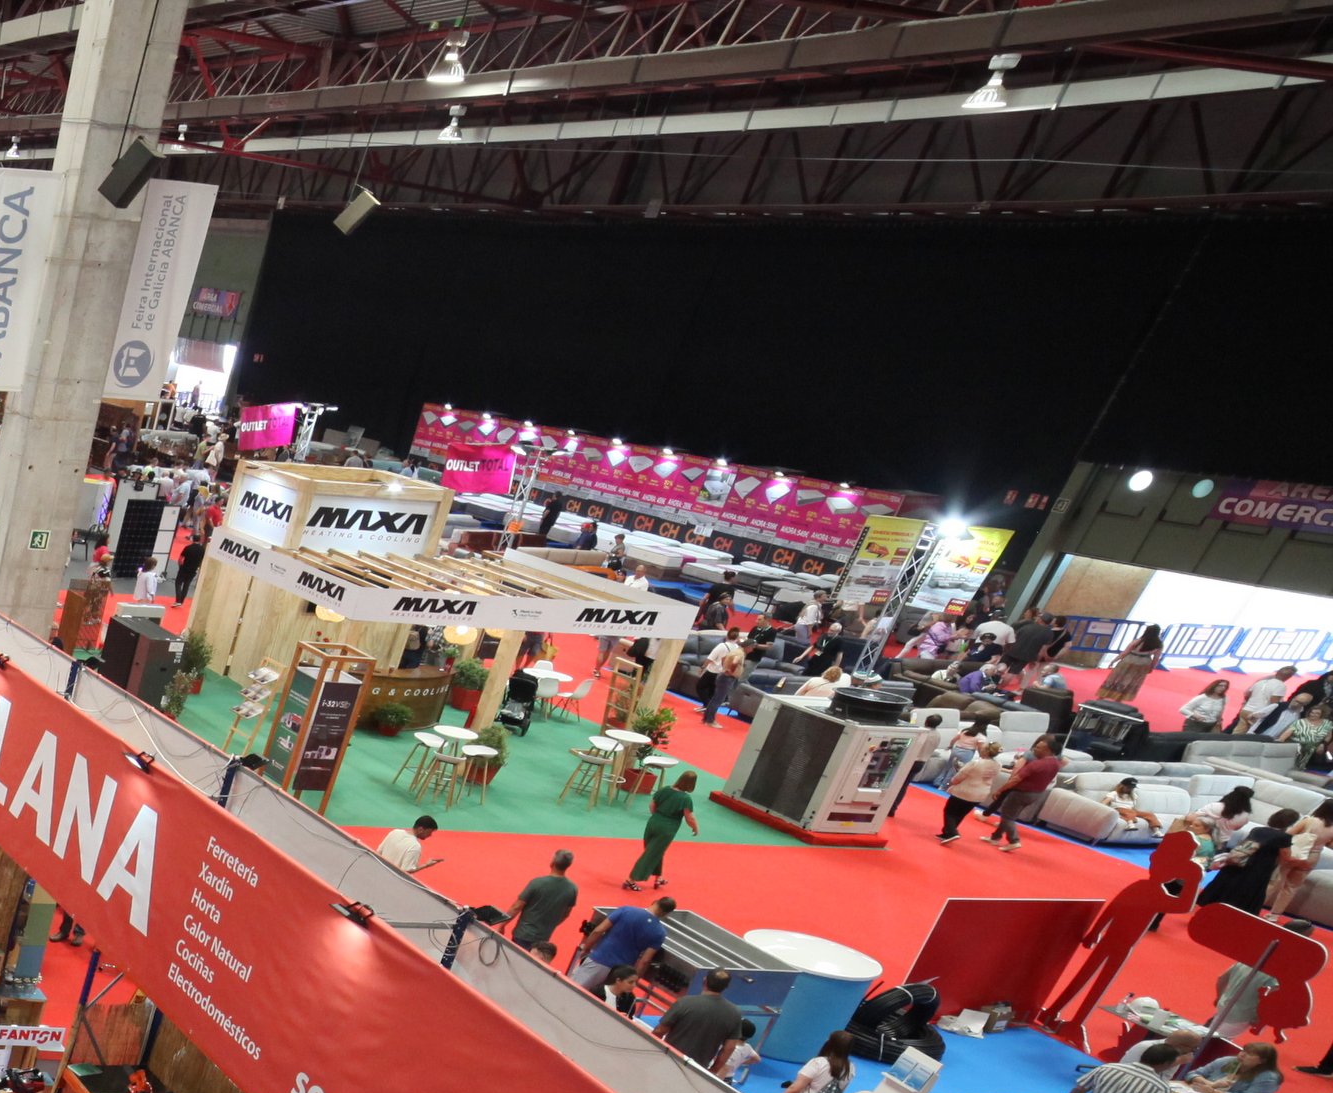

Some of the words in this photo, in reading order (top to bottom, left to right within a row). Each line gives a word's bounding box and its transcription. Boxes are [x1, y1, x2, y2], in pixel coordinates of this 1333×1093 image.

[164, 193, 188, 258] ABANCA
[131, 302, 147, 330] Feira
[141, 194, 174, 300] Internacional
[149, 262, 167, 310] Galicia
[145, 315, 156, 332] de
[241, 420, 267, 433] OUTLET
[445, 459, 480, 472] OUTLET
[239, 490, 293, 521] MAXA
[587, 504, 604, 520] CH
[611, 509, 628, 524] CH
[1218, 498, 1333, 527] COMERC
[306, 506, 430, 534] MAXA
[634, 515, 654, 532] CH
[659, 522, 680, 539] CH
[303, 529, 353, 540] HEATING
[369, 534, 422, 545] COOLING
[713, 536, 733, 552] CH
[219, 538, 261, 565] MAXA
[744, 542, 762, 557] CH
[772, 549, 796, 565] CH
[802, 558, 826, 575] CH
[297, 571, 345, 602] MAXA
[393, 597, 479, 616] MAXA
[577, 607, 660, 625] MAXA
[206, 835, 259, 888] Ferretería
[198, 861, 234, 902] Xardín
[190, 887, 221, 924] Horta
[183, 914, 211, 947] Calor
[210, 936, 253, 983] Natural
[176, 939, 215, 984] Cociñas
[167, 962, 262, 1062] Electrodomésticos
